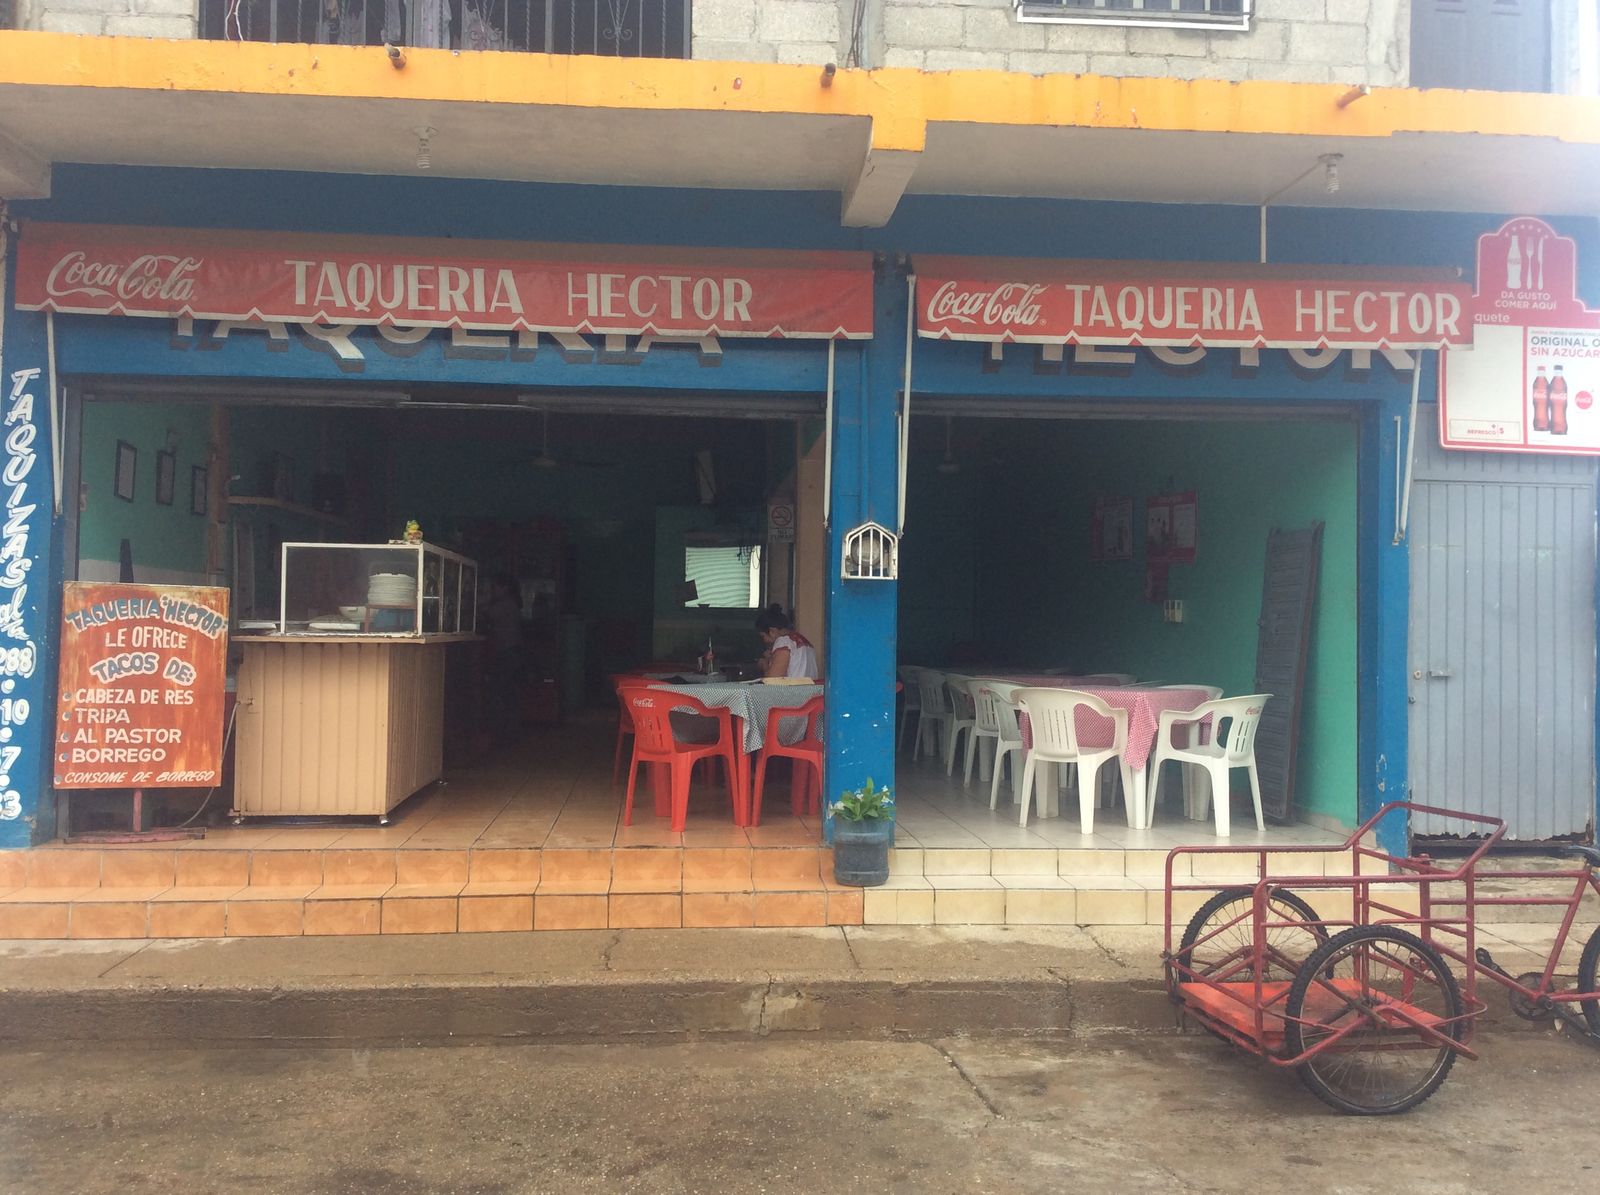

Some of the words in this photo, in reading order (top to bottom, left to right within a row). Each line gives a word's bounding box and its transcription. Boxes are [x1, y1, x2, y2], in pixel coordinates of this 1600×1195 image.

[284, 259, 524, 314] TAQUERIA
[567, 271, 752, 322] HECTOR
[1501, 291, 1514, 299] DA
[1517, 291, 1551, 300] GUSTO
[1065, 284, 1263, 331] TAQUERIA
[1295, 289, 1461, 336] HECTOR
[1495, 300, 1529, 309] COMER
[1474, 313, 1510, 323] quete
[1531, 336, 1588, 347] ORIGINAL
[1531, 347, 1549, 356] SIN
[1, 368, 41, 588] TAQUIZAS
[65, 597, 160, 633] TAQUERIA
[105, 628, 127, 648] LE
[132, 626, 188, 649] OFRECE
[89, 652, 159, 684] TACOS
[76, 688, 135, 704] CABEZA
[140, 689, 159, 704] DE
[165, 689, 194, 705] RES
[75, 708, 130, 724] TRIPA
[74, 728, 97, 743] AL
[105, 728, 182, 743] PASTOR
[72, 748, 166, 763] BORREGO
[64, 772, 128, 783] CONSOME
[131, 771, 153, 782] DE
[156, 770, 215, 782] BORREGO
